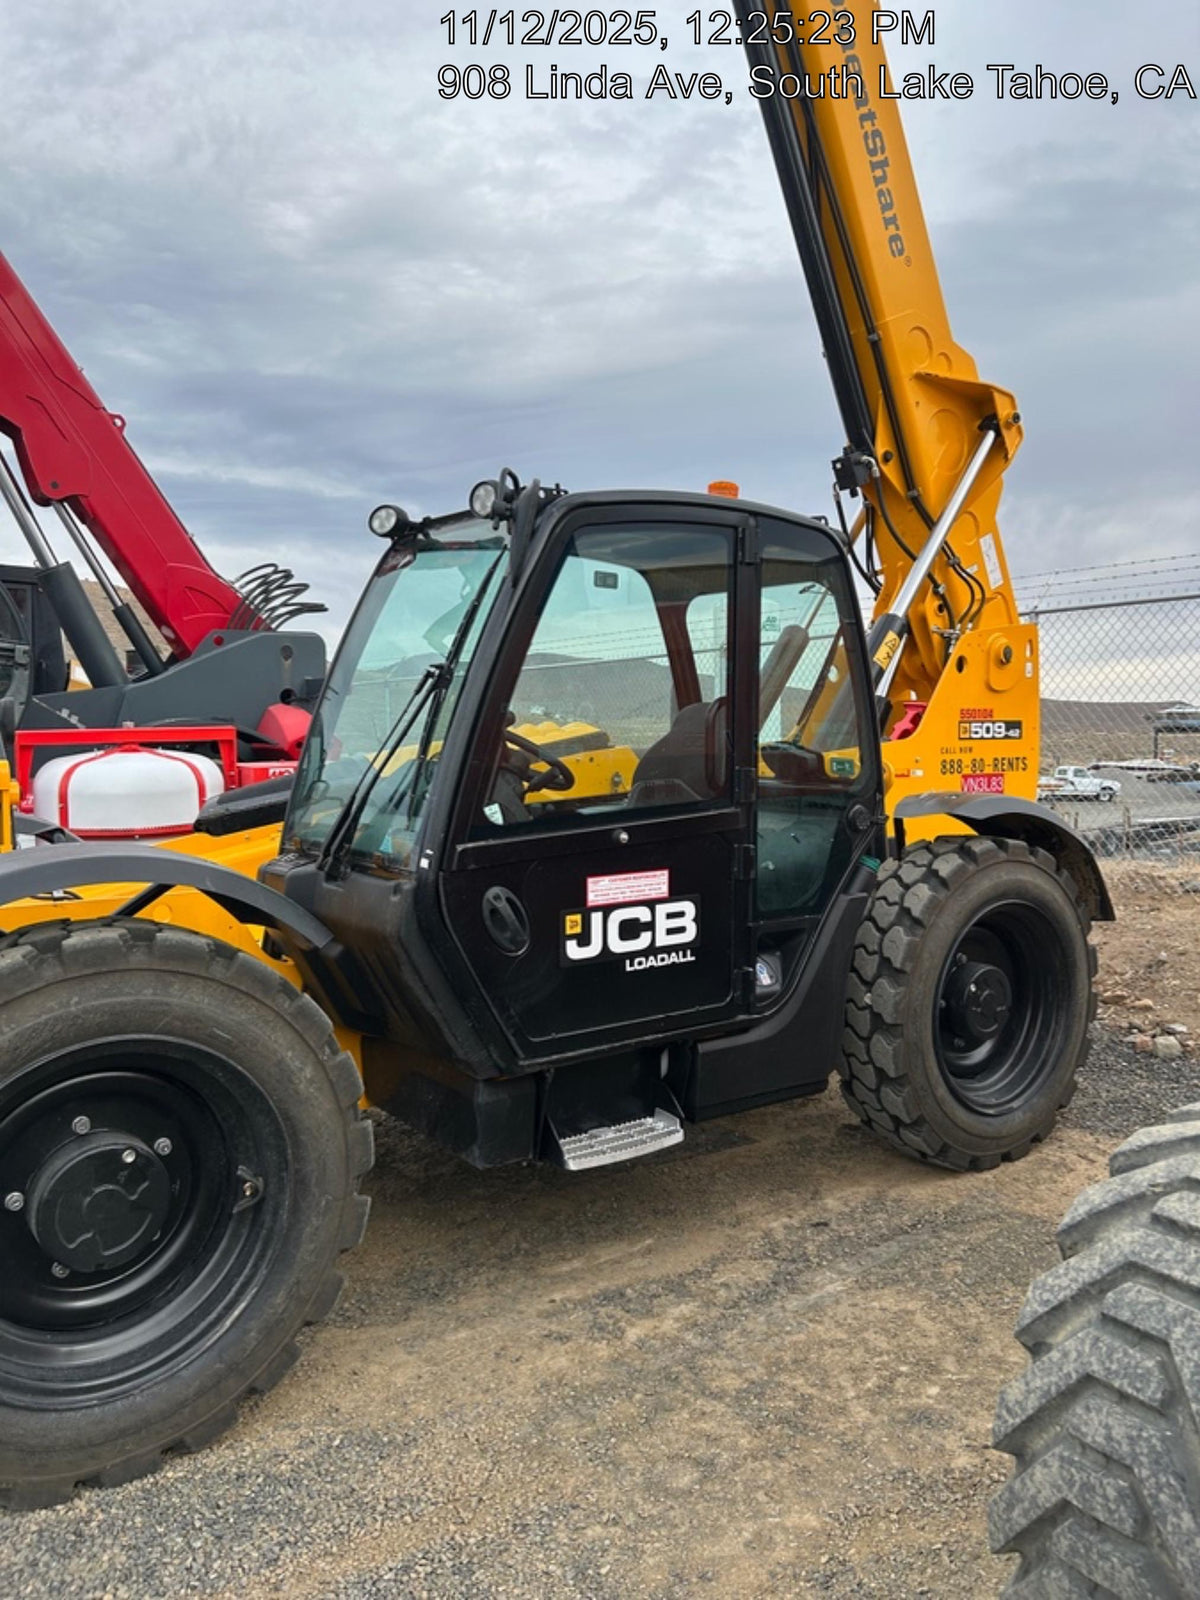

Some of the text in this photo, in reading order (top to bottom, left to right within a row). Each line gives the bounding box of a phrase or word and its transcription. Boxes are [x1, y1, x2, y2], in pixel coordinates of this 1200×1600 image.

[940, 746, 957, 754] CALL
[940, 757, 1028, 775] 888-80-RENTS
[565, 900, 697, 960] JCB
[625, 949, 696, 972] LOADALL
